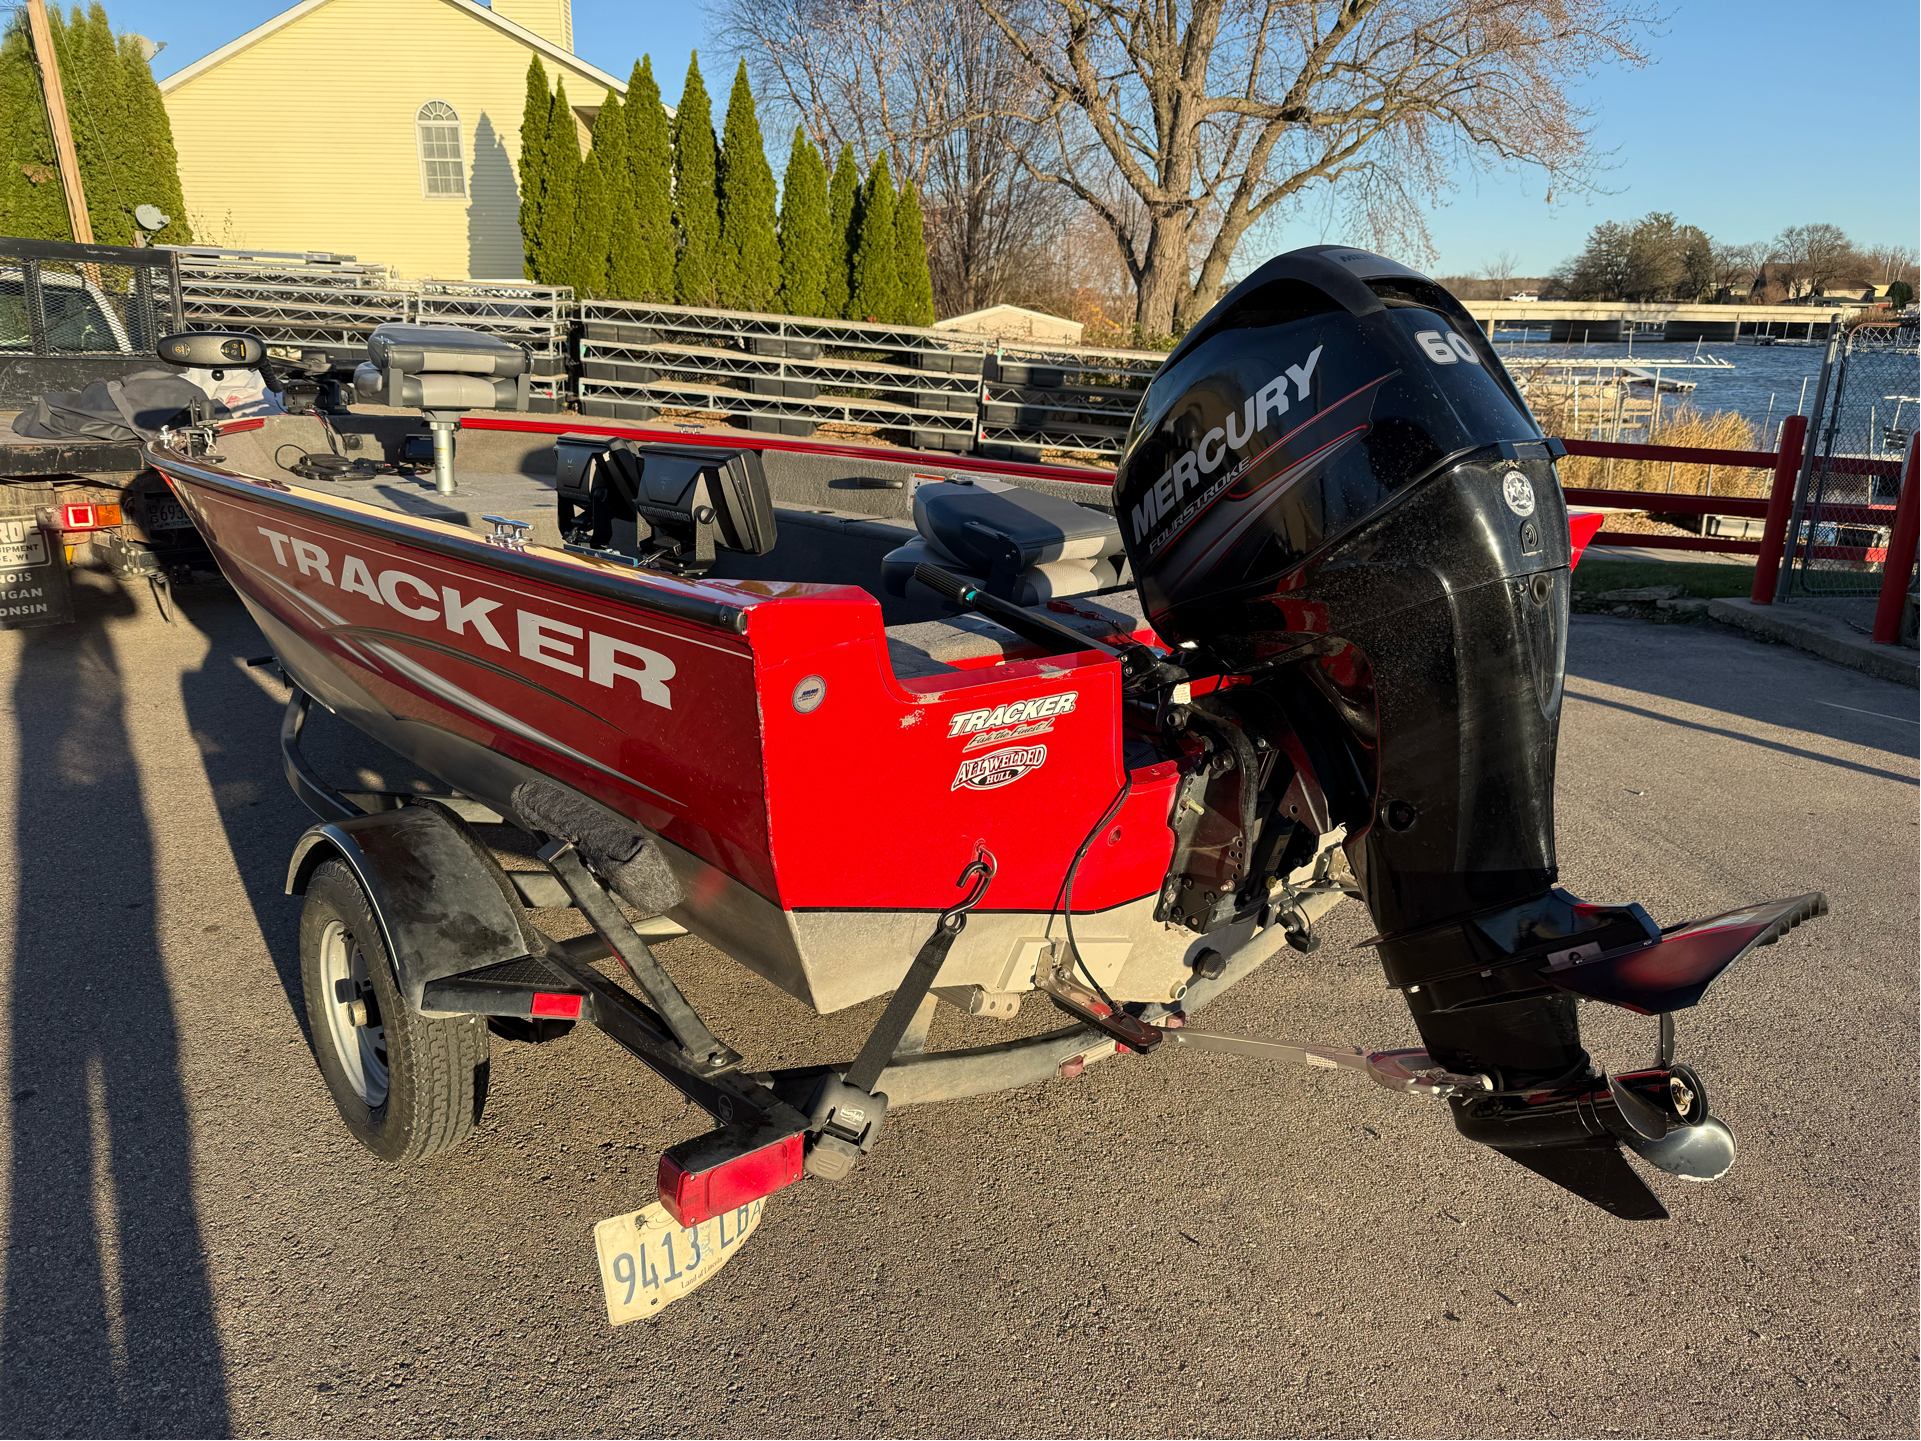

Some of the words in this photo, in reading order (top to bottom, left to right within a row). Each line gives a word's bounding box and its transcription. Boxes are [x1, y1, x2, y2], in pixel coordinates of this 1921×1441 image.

[1414, 329, 1480, 365] 60
[1131, 345, 1323, 545] MERCURY
[1149, 456, 1251, 554] FOURSTROKE
[257, 525, 677, 710] TRACKER
[968, 734, 992, 746] Fish
[993, 730, 1010, 740] the
[985, 770, 1012, 785] HULL
[613, 1225, 701, 1305] 9413
[681, 1274, 697, 1289] Land
[704, 1257, 723, 1274] Lincoln
